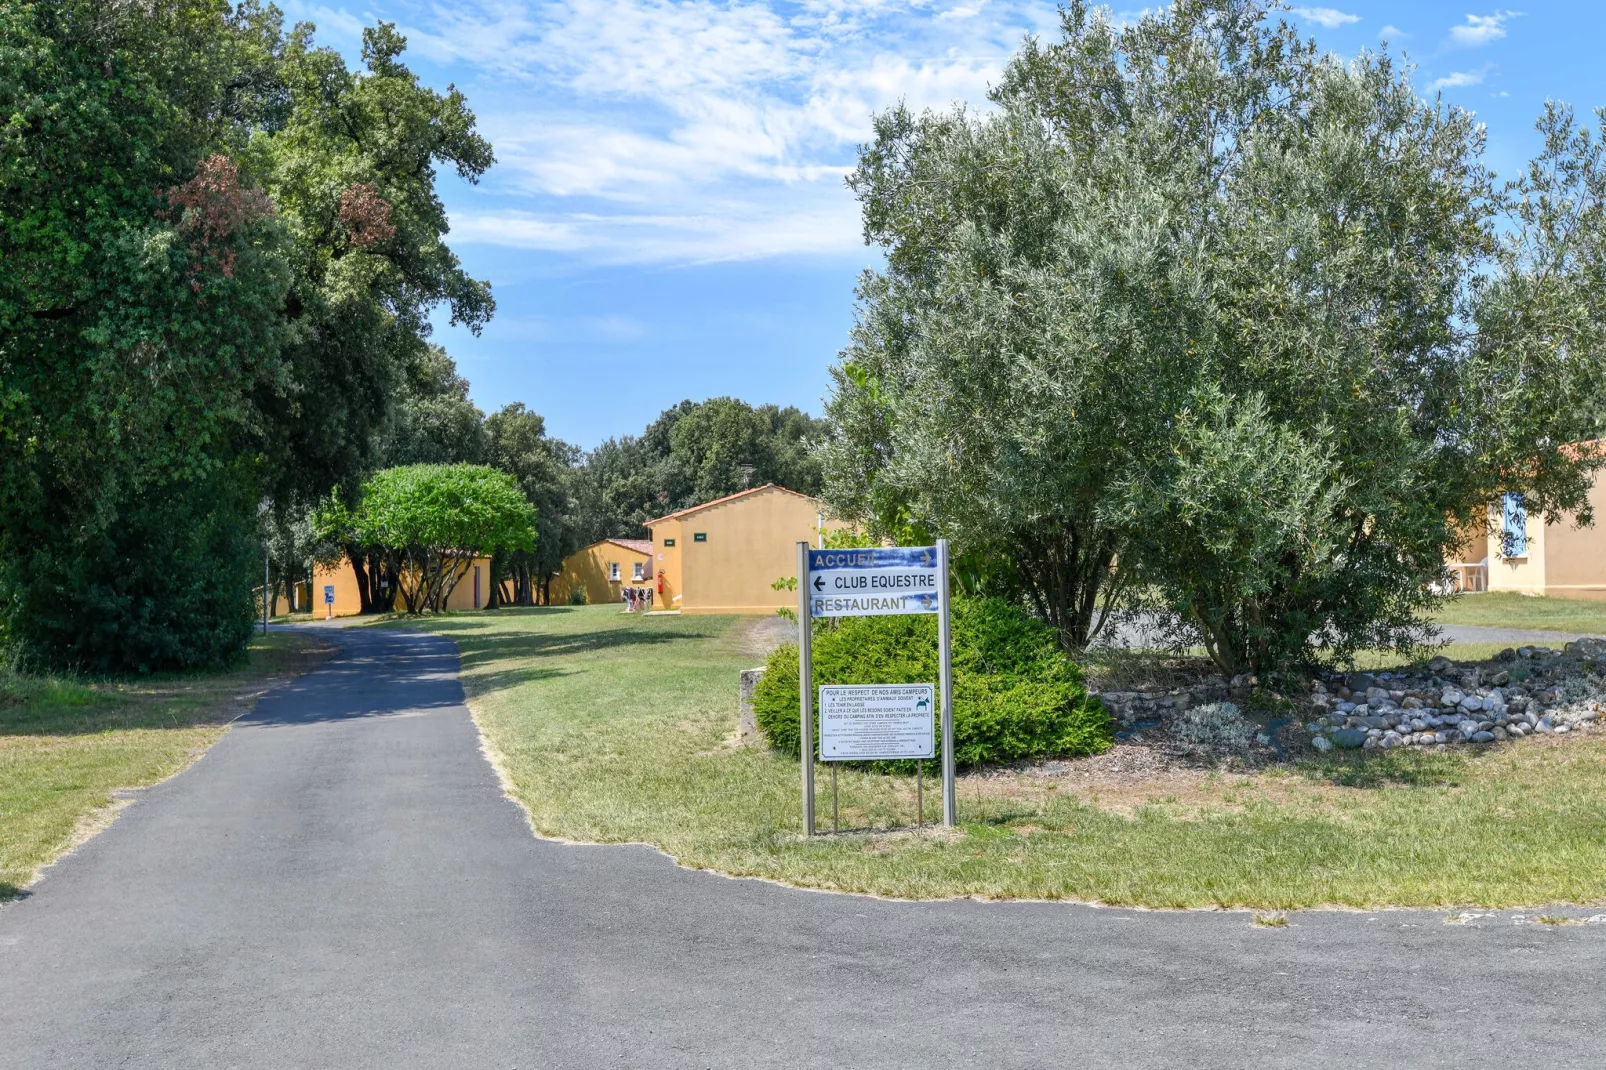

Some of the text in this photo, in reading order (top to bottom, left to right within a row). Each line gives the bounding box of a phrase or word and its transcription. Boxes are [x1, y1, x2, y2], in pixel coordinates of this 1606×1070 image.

[815, 554, 879, 566] ACCUEIL
[835, 574, 934, 588] CLUB EQUESTRE
[815, 597, 908, 612] RESTAURANT
